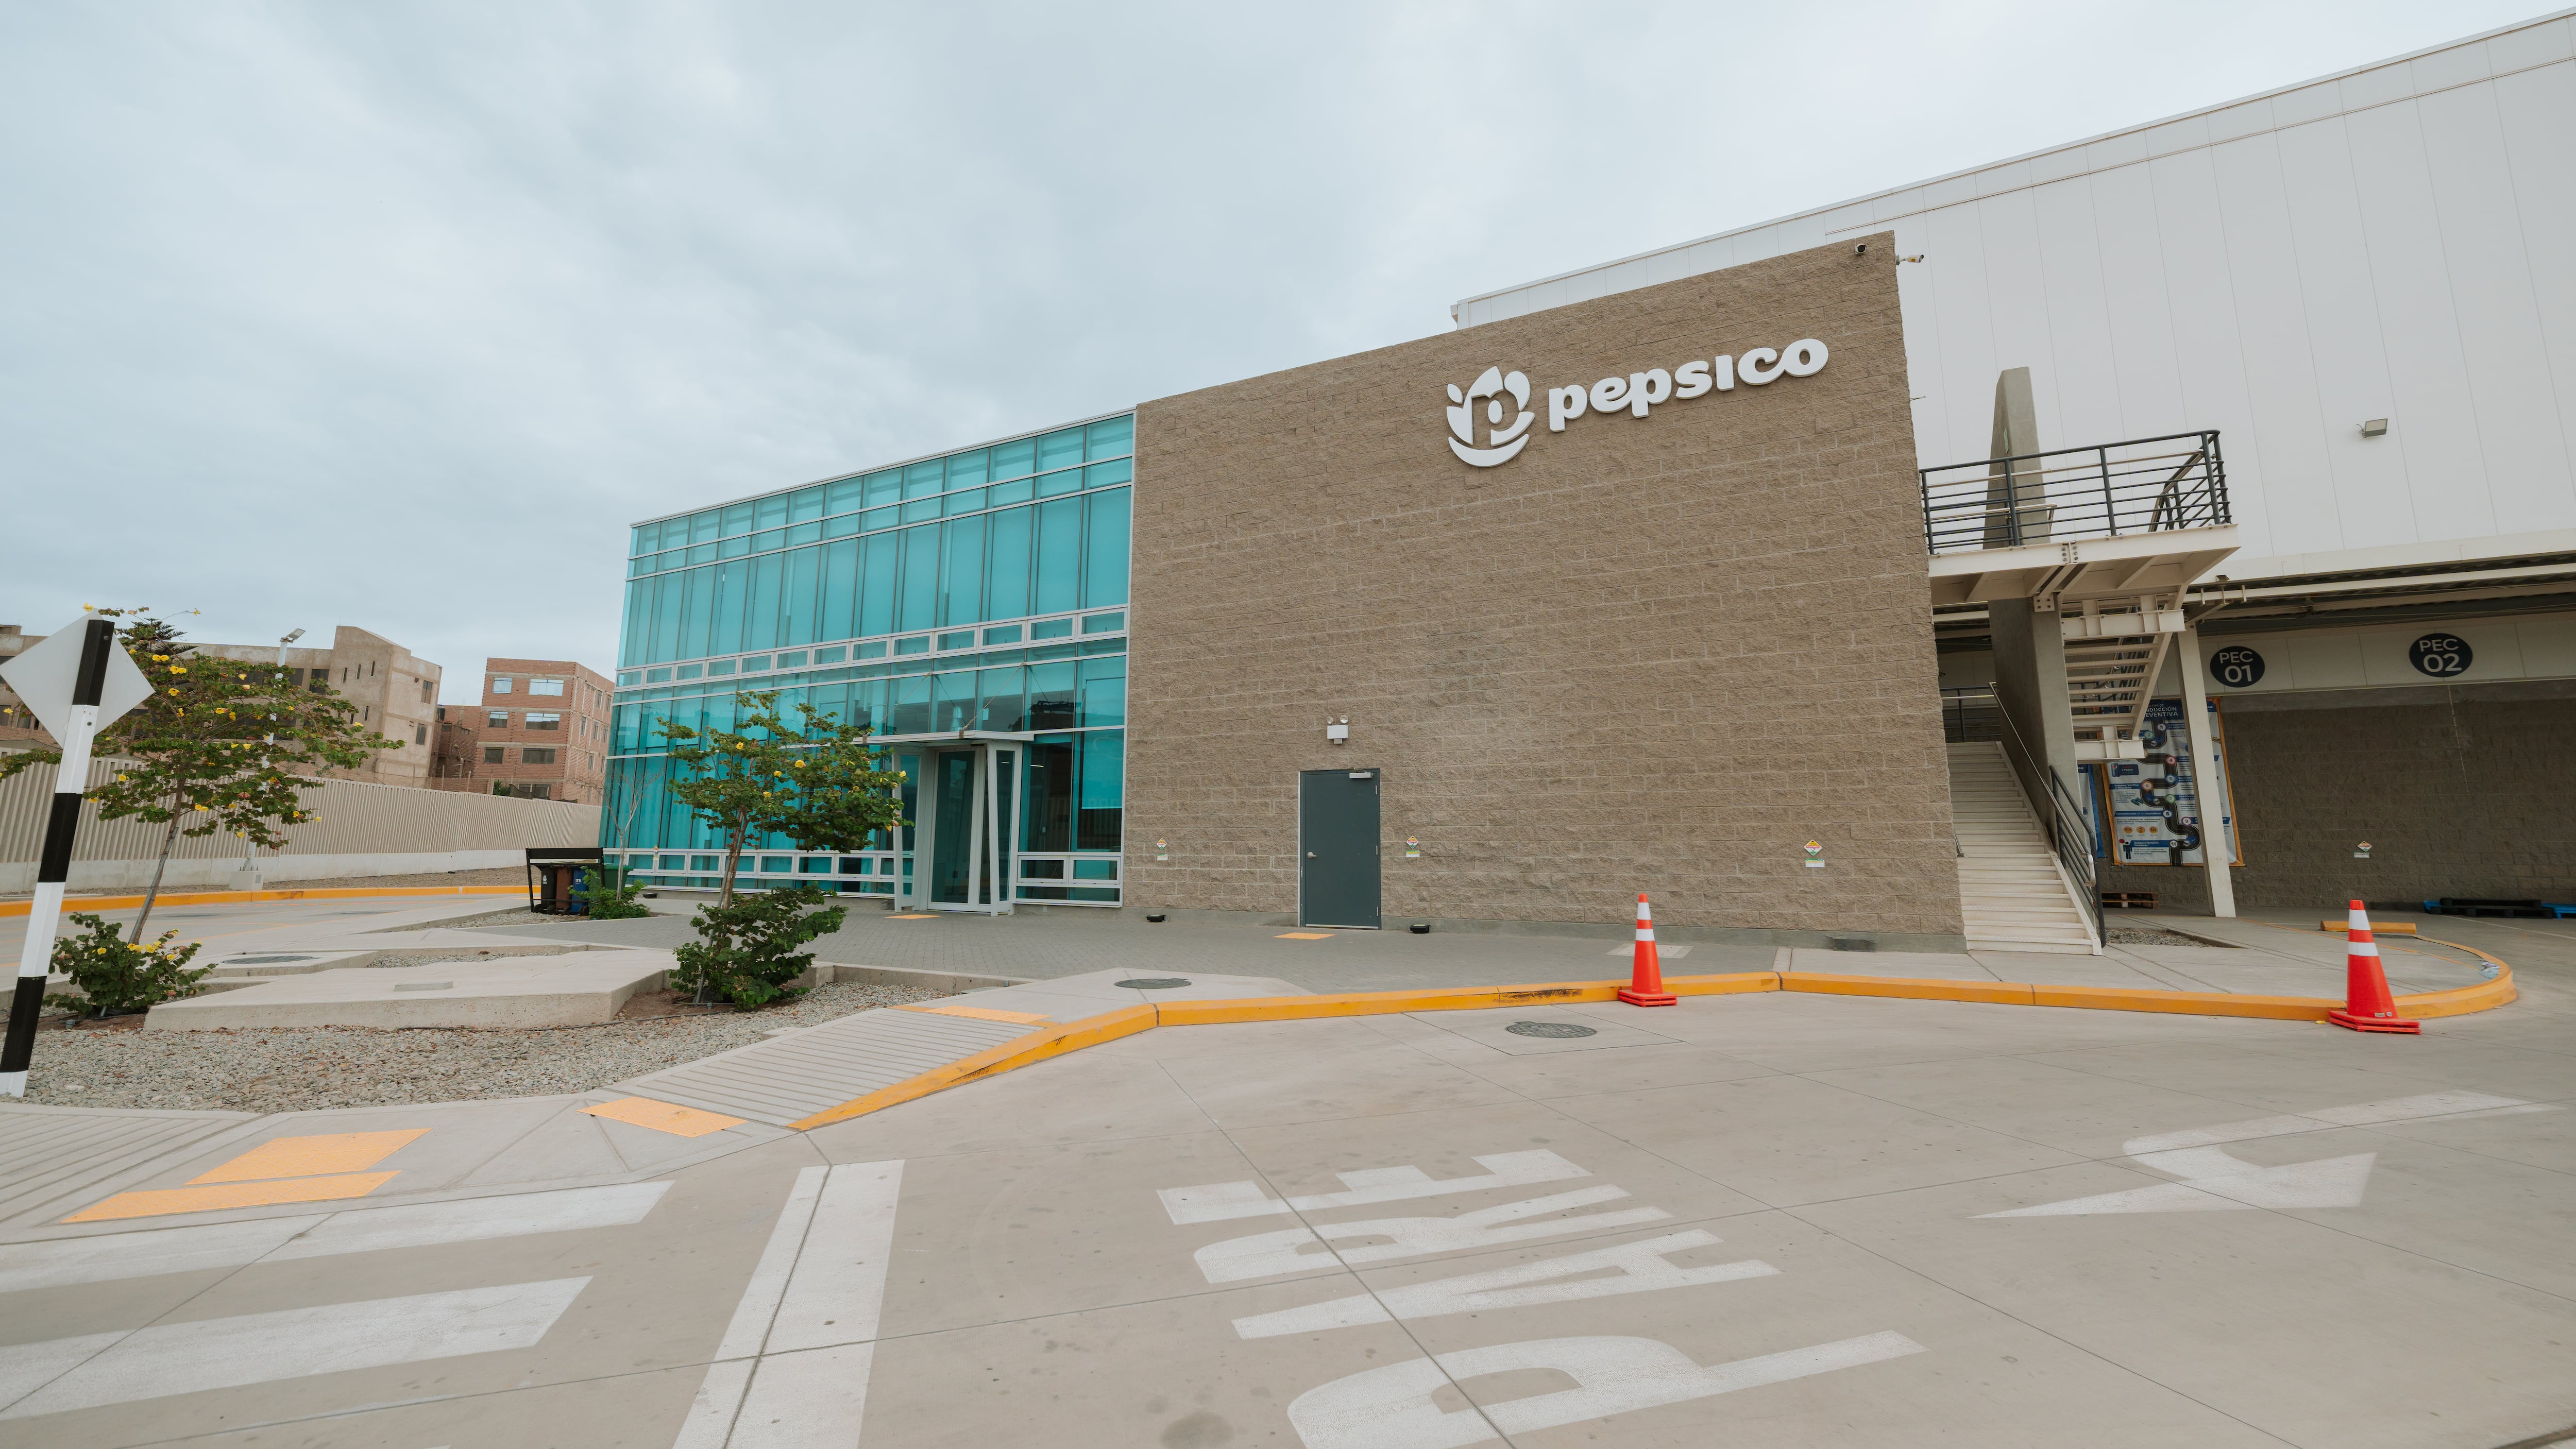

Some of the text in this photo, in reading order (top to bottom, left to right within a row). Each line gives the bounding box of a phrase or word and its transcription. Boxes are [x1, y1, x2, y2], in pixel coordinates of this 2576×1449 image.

[1549, 338, 1829, 432] pepsico
[2419, 639, 2459, 652] PEC
[2219, 651, 2253, 663] PEC
[2424, 653, 2462, 672] 02
[2225, 665, 2252, 683] 01
[1157, 1149, 1931, 1449] PARE
